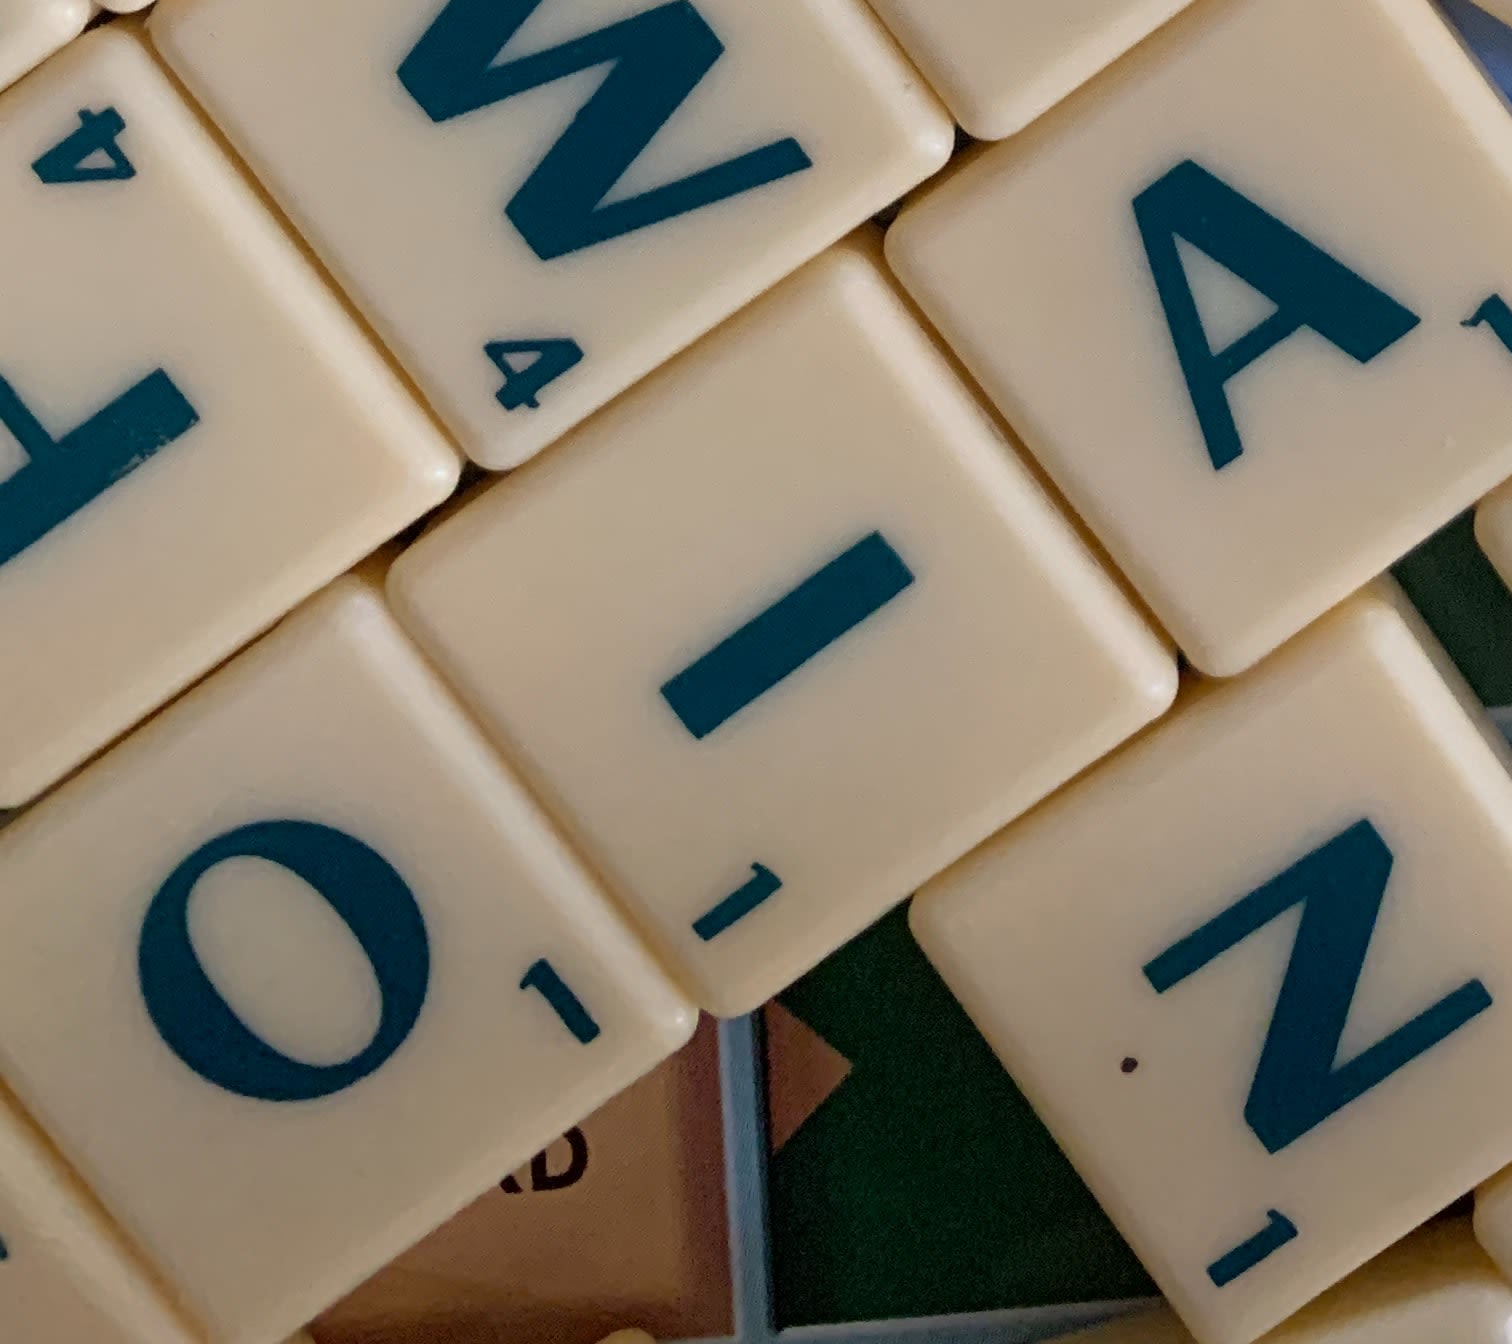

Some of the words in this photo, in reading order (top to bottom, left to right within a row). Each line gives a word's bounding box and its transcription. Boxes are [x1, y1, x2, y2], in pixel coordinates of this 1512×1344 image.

[31, 107, 135, 184] 4
[1132, 160, 1420, 470] A
[484, 338, 584, 411] 4
[661, 533, 913, 739] I
[692, 862, 782, 941] 1
[139, 820, 430, 1101] O
[520, 959, 600, 1044] 1
[1142, 818, 1492, 1153] N
[1206, 1209, 1298, 1287] 1
